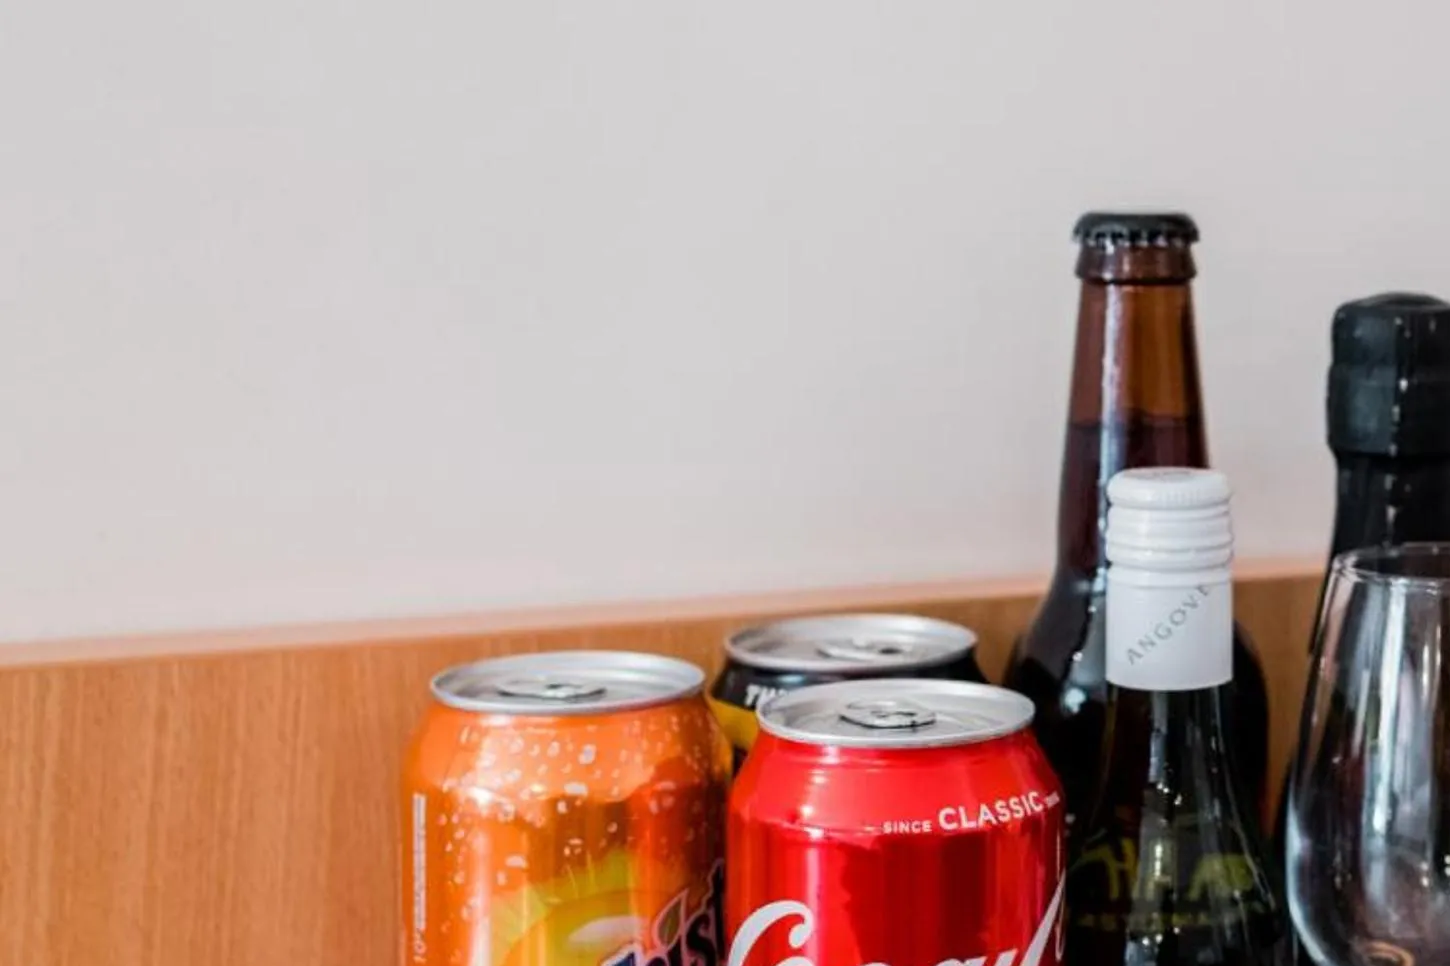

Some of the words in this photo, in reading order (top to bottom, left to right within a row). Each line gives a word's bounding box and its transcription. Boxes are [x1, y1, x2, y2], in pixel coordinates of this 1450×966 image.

[1125, 584, 1210, 666] ANGOVE
[883, 819, 932, 834] SINCE
[938, 791, 1045, 831] CLASSIC
